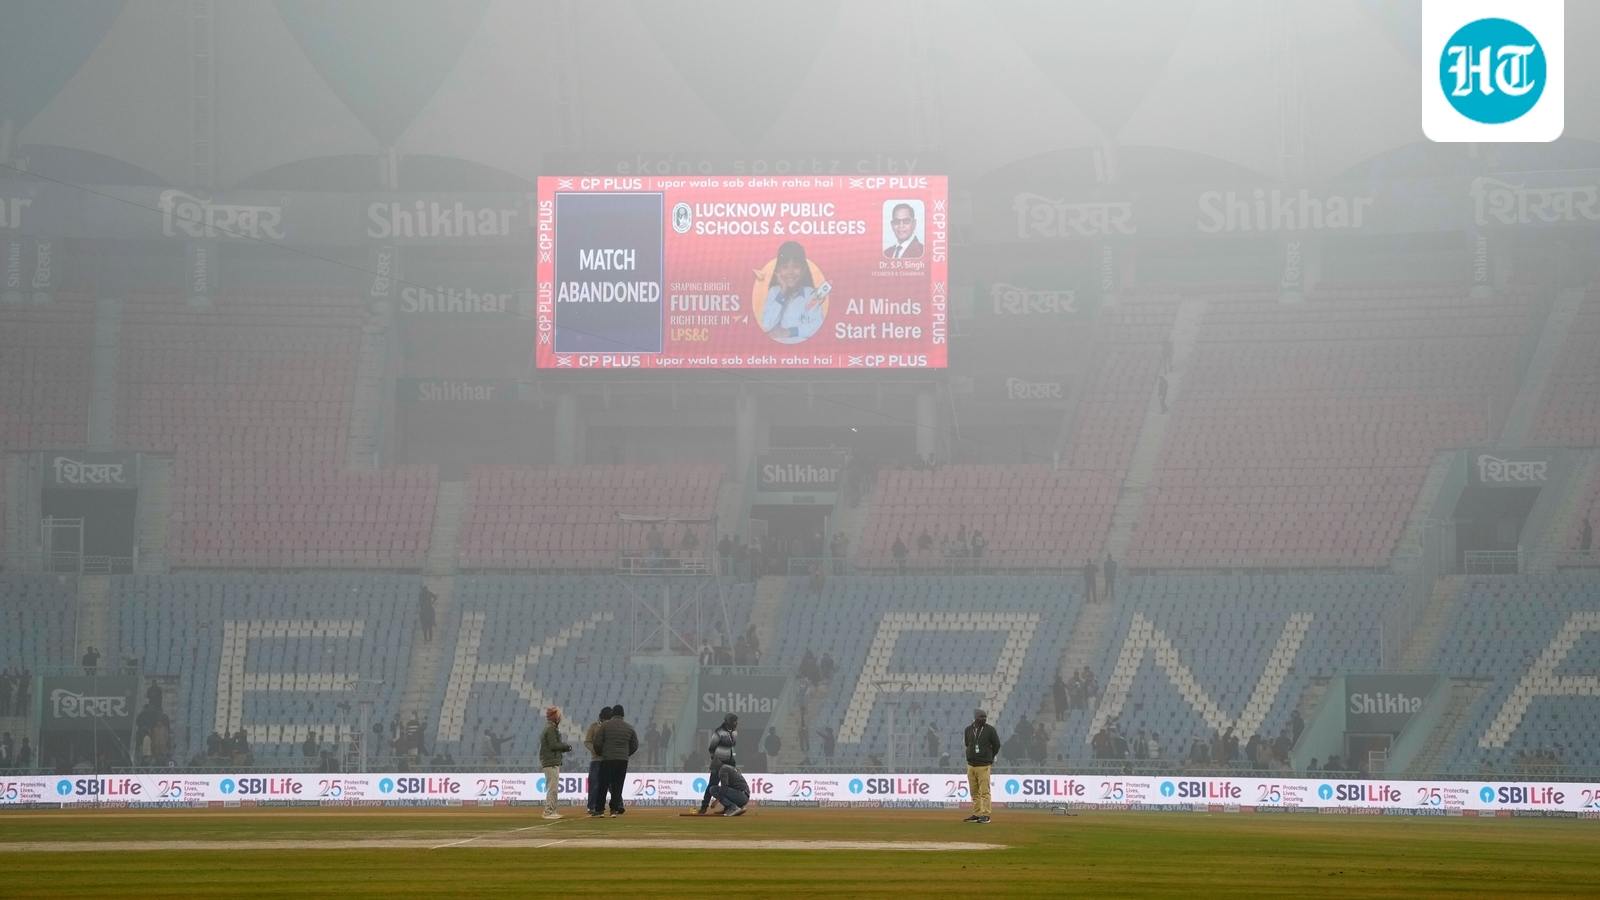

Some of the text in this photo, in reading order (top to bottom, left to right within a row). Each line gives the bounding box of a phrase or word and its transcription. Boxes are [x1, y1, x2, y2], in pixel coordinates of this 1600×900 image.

[733, 157, 840, 176] sportz
[856, 154, 919, 177] city
[580, 177, 927, 190] CP PLUS upar wala sab dekh raha hai CP PLUS
[1470, 176, 1600, 226] शिखर
[158, 189, 285, 239] शिखर
[367, 200, 519, 239] Shikhar
[695, 203, 777, 218] LUCKNOW
[780, 203, 835, 218] PUBLIC
[1013, 192, 1137, 239] शिखर
[1198, 188, 1375, 233] Shikhar
[540, 200, 553, 250] CP PLUS
[695, 220, 866, 235] SCHOOLS & COLLEGES
[933, 213, 946, 263] CP PLUS
[8, 241, 21, 288] Shikhar
[579, 249, 636, 270] MATCH
[879, 261, 925, 271] Dr. S.P. Singh
[1102, 244, 1114, 291] Shikhar
[1475, 235, 1487, 282] Shikhar
[194, 245, 207, 292] Shikhar
[558, 282, 660, 303] ABANDONED
[670, 282, 731, 291] SHAPING BRIGHT
[401, 286, 513, 313] Shikhar
[539, 282, 552, 331] CP PLUS
[670, 294, 740, 311] FUTURES
[846, 298, 922, 315] AI Minds
[990, 282, 1078, 315] शिखर
[670, 315, 730, 325] RIGHT HERE IN
[933, 295, 946, 345] CP PLUS
[670, 328, 709, 342] LPS&C
[835, 322, 922, 339] Start Here
[579, 355, 927, 367] CP PLUS upar wala sab dekh raha hai CP PLUS
[418, 381, 496, 401] Shikhar
[1006, 377, 1062, 399] शिखर
[53, 456, 126, 484] शिखर
[763, 463, 841, 483] Shikhar
[1477, 454, 1548, 482] शिखर
[50, 688, 129, 718] शिखर
[1350, 692, 1423, 714] Shikha
[75, 778, 142, 796] SBI Life
[157, 780, 182, 798] 25
[238, 777, 303, 794] SBI Life
[318, 779, 342, 797] 25
[397, 777, 461, 793] SBI Life
[476, 778, 500, 796] 25
[632, 778, 656, 796] 25
[750, 777, 774, 794] ife
[789, 780, 812, 797] 25
[866, 778, 930, 795] SBI Life
[945, 780, 969, 798] 25
[1022, 779, 1086, 796] SBI Life
[1101, 782, 1124, 800] 25
[1178, 781, 1242, 799] SBI Life
[1257, 784, 1281, 802] 25
[1336, 784, 1402, 802] SBI Life
[1417, 787, 1442, 806] 25
[1498, 786, 1566, 805] SBI Life
